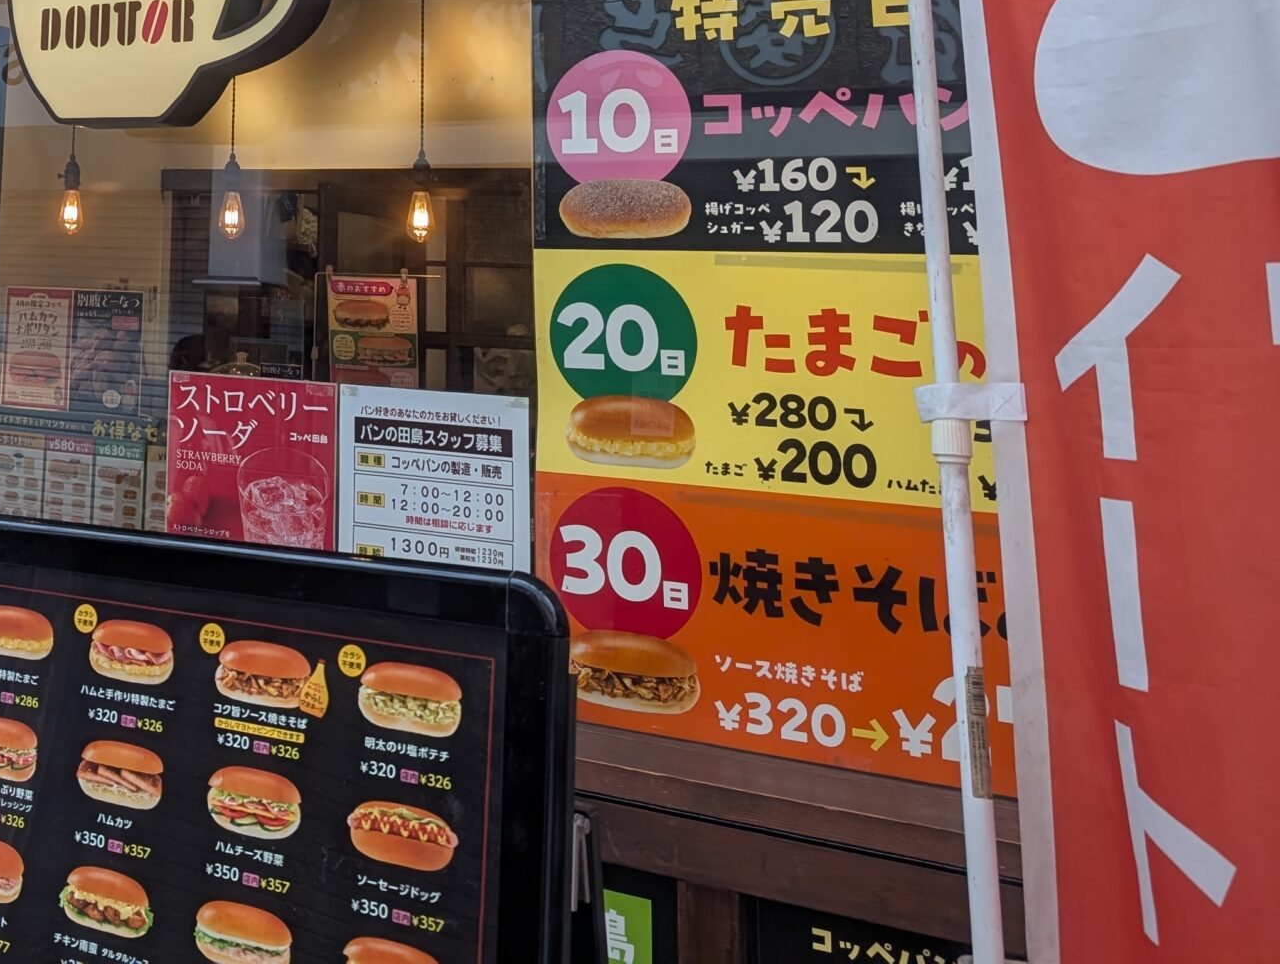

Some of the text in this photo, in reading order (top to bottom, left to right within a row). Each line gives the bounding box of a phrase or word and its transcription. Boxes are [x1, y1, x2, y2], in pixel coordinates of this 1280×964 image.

[558, 88, 679, 155] 10日
[733, 157, 837, 193] ¥160
[704, 202, 770, 217] 揚げコッペ
[759, 199, 879, 243] ¥120
[706, 221, 755, 234] シュガー
[337, 282, 386, 293] 春のおすすめ
[76, 293, 140, 308] 別腹どーなつ
[16, 323, 60, 336] ナポリタン
[19, 311, 58, 323] ハムカツ
[556, 301, 685, 376] 20日
[177, 384, 329, 422] ストロベリー
[727, 392, 837, 432] ¥280
[49, 439, 75, 451] ¥580
[176, 418, 258, 450] ソーダ
[290, 432, 328, 444] コッペ田島
[361, 424, 502, 453] パンの田島スタッフ募集
[98, 445, 126, 457] ¥630
[176, 449, 242, 465] STRAWBERRY
[754, 437, 878, 489] ¥200
[176, 460, 203, 472] SODA
[391, 456, 502, 480] コッペパンの製造・販売
[705, 460, 748, 477] たまご
[360, 494, 382, 505] 時間
[405, 515, 494, 534] 時間は相談に応じます
[391, 537, 449, 559] 1300円
[559, 524, 689, 611] 30日
[1055, 252, 1237, 947] イート
[78, 610, 95, 618] カラシ
[203, 630, 221, 638] カラシ
[342, 651, 362, 660] カラシ
[714, 654, 865, 694] ソース焼きそば
[15, 696, 39, 708] ¥286
[80, 685, 176, 711] ハムと手作り特製たまご
[88, 708, 163, 733] ¥320 ¥326
[213, 703, 308, 729] コク旨ソース焼きそば
[714, 692, 846, 749] ¥320
[217, 733, 300, 760] ¥320 ¥326
[364, 736, 450, 762] 明太のり塩ポテチ
[360, 761, 452, 790] ¥320 ¥326
[0, 813, 25, 829] ¥326
[97, 813, 133, 829] ハムカツ
[74, 831, 151, 860] ¥350 ¥357
[215, 841, 285, 868] ハムチーズ野菜
[206, 863, 290, 895] ¥350 ¥357
[357, 874, 442, 905] ソーセージドッグ
[351, 899, 445, 934] ¥350 ¥357
[53, 932, 98, 955] チキン南蛮
